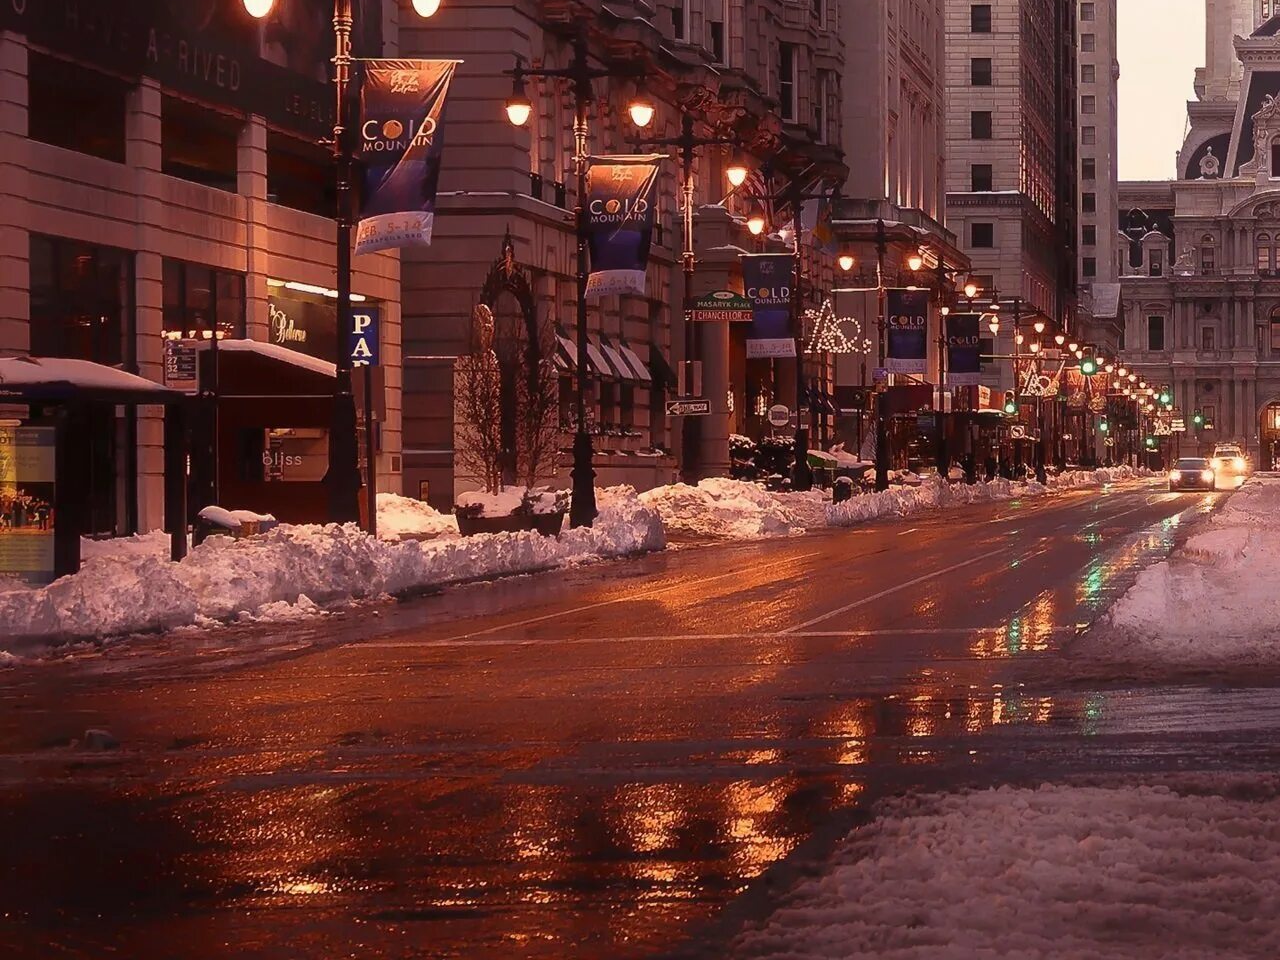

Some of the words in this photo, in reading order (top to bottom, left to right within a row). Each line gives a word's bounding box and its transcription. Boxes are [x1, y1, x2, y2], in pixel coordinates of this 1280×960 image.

[747, 287, 790, 299] COLD
[698, 311, 742, 320] CHANCELLOR
[889, 315, 924, 326] COLD
[167, 365, 178, 373] 32
